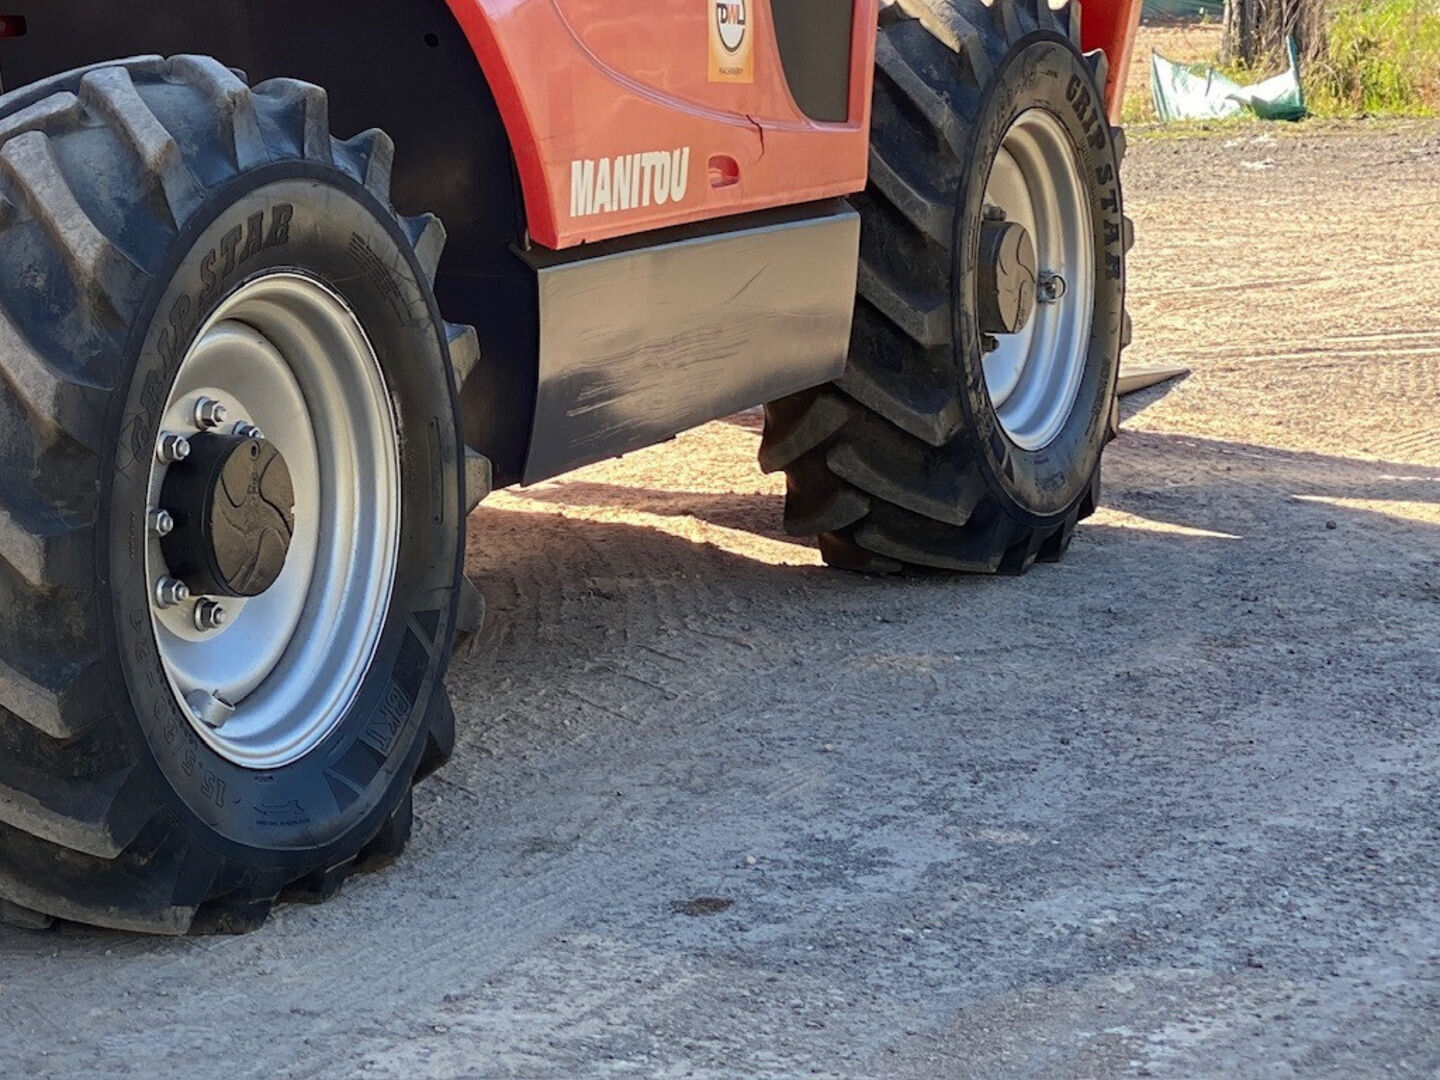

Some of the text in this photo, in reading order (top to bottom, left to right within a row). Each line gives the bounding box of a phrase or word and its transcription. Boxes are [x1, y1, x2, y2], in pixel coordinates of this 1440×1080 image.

[569, 146, 690, 218] MANITOU
[1065, 73, 1106, 152] GRIP
[1095, 163, 1120, 280] STAR
[198, 203, 294, 318] STAR
[366, 678, 411, 753] BKT
